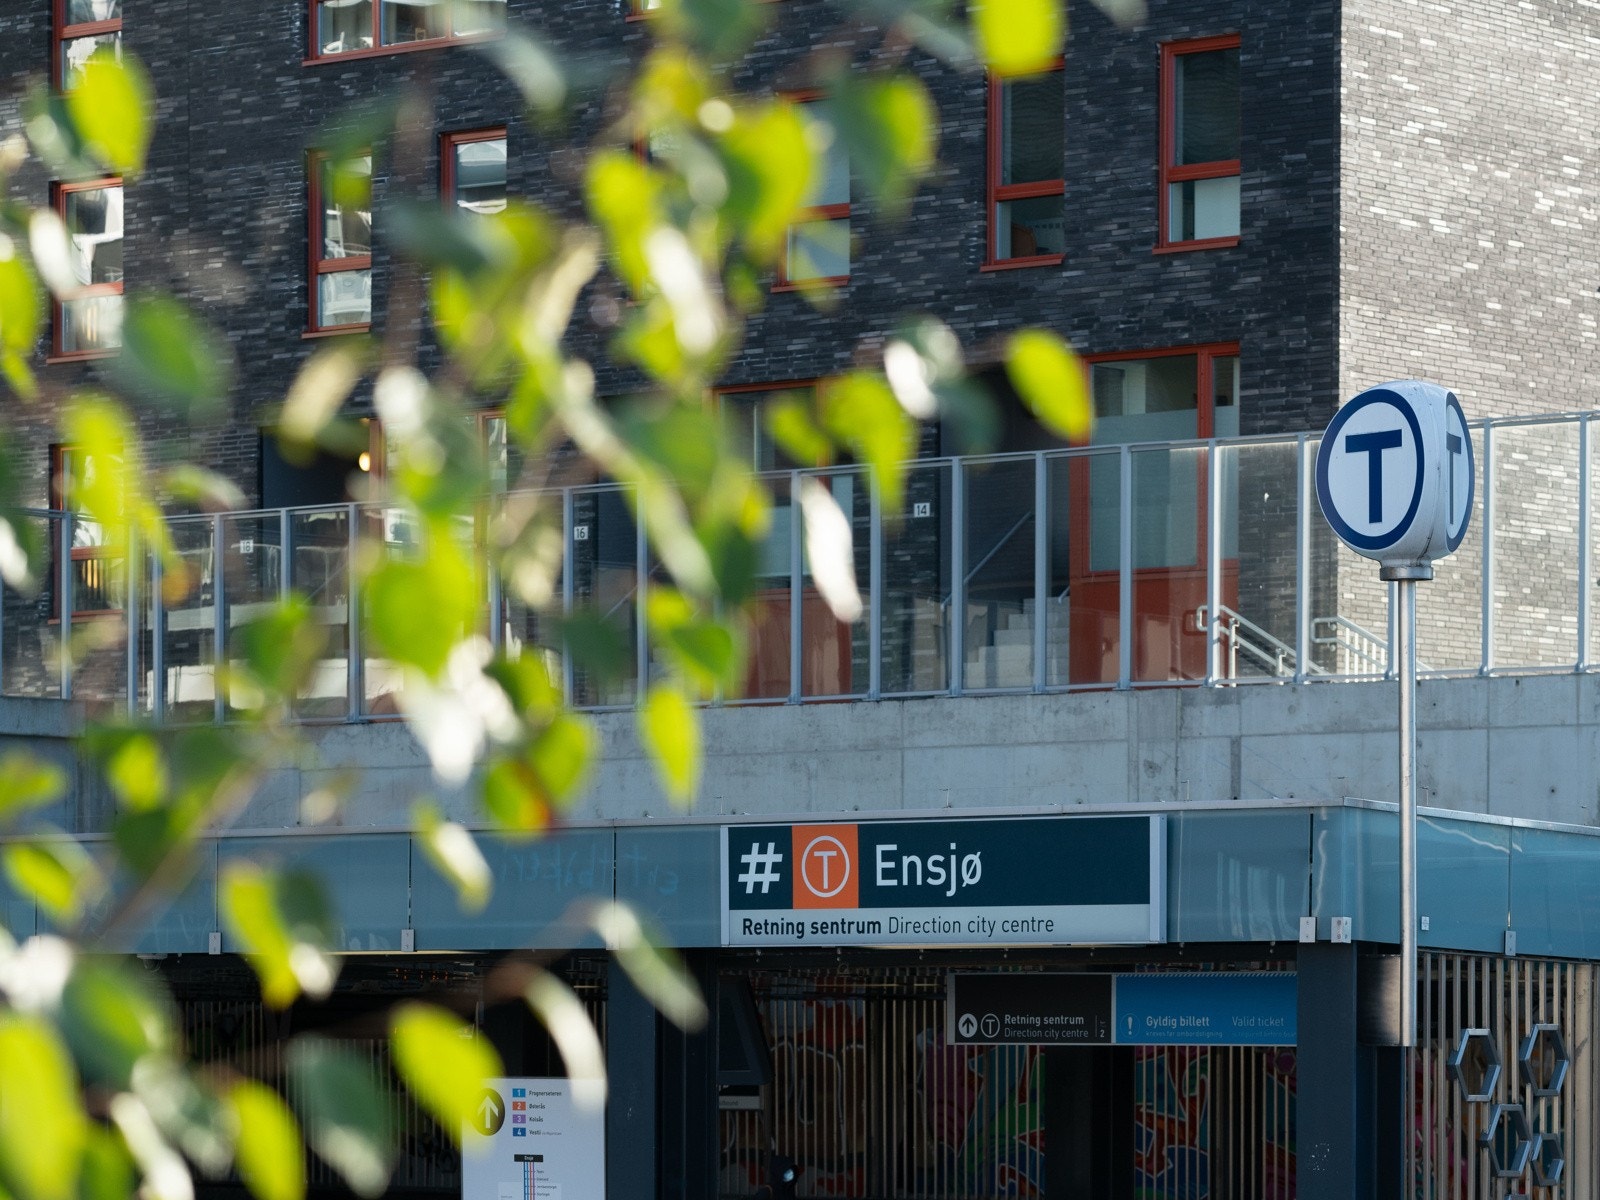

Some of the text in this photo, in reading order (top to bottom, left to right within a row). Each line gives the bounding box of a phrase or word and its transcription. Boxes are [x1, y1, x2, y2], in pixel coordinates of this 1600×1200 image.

[1345, 429, 1403, 524] T
[917, 504, 927, 516] 14
[576, 527, 586, 539] 16
[875, 842, 983, 897] Ensjø
[742, 915, 1054, 940] Retning sentrum Direction city centre
[1004, 1014, 1041, 1027] Retning
[1043, 1014, 1084, 1025] sentrum
[1146, 1015, 1210, 1030] Gyldig billett
[1231, 1016, 1285, 1028] Valid ticket
[1004, 1027, 1089, 1040] Direction city centre
[1100, 1029, 1105, 1038] 2
